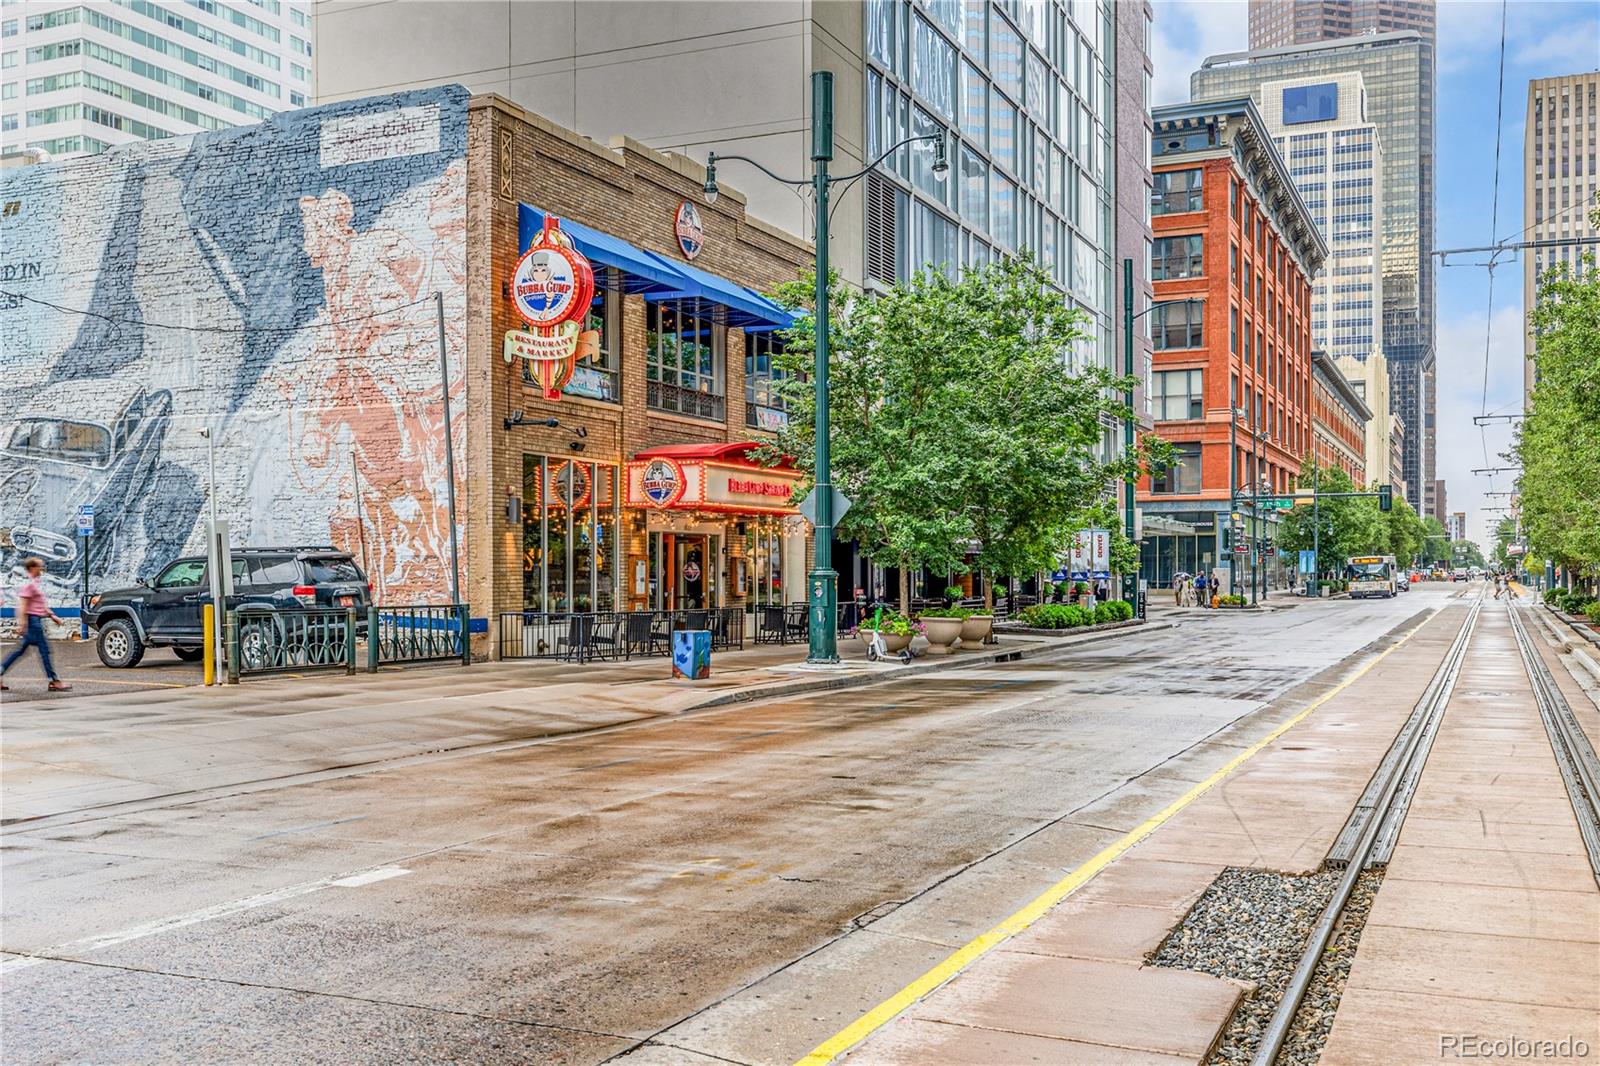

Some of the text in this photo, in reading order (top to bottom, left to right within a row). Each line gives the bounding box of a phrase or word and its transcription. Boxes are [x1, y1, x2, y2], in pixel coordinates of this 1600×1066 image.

[517, 281, 571, 297] BUBBA GUMP
[514, 335, 574, 347] RESTAURANT
[516, 344, 569, 357] & MARKET
